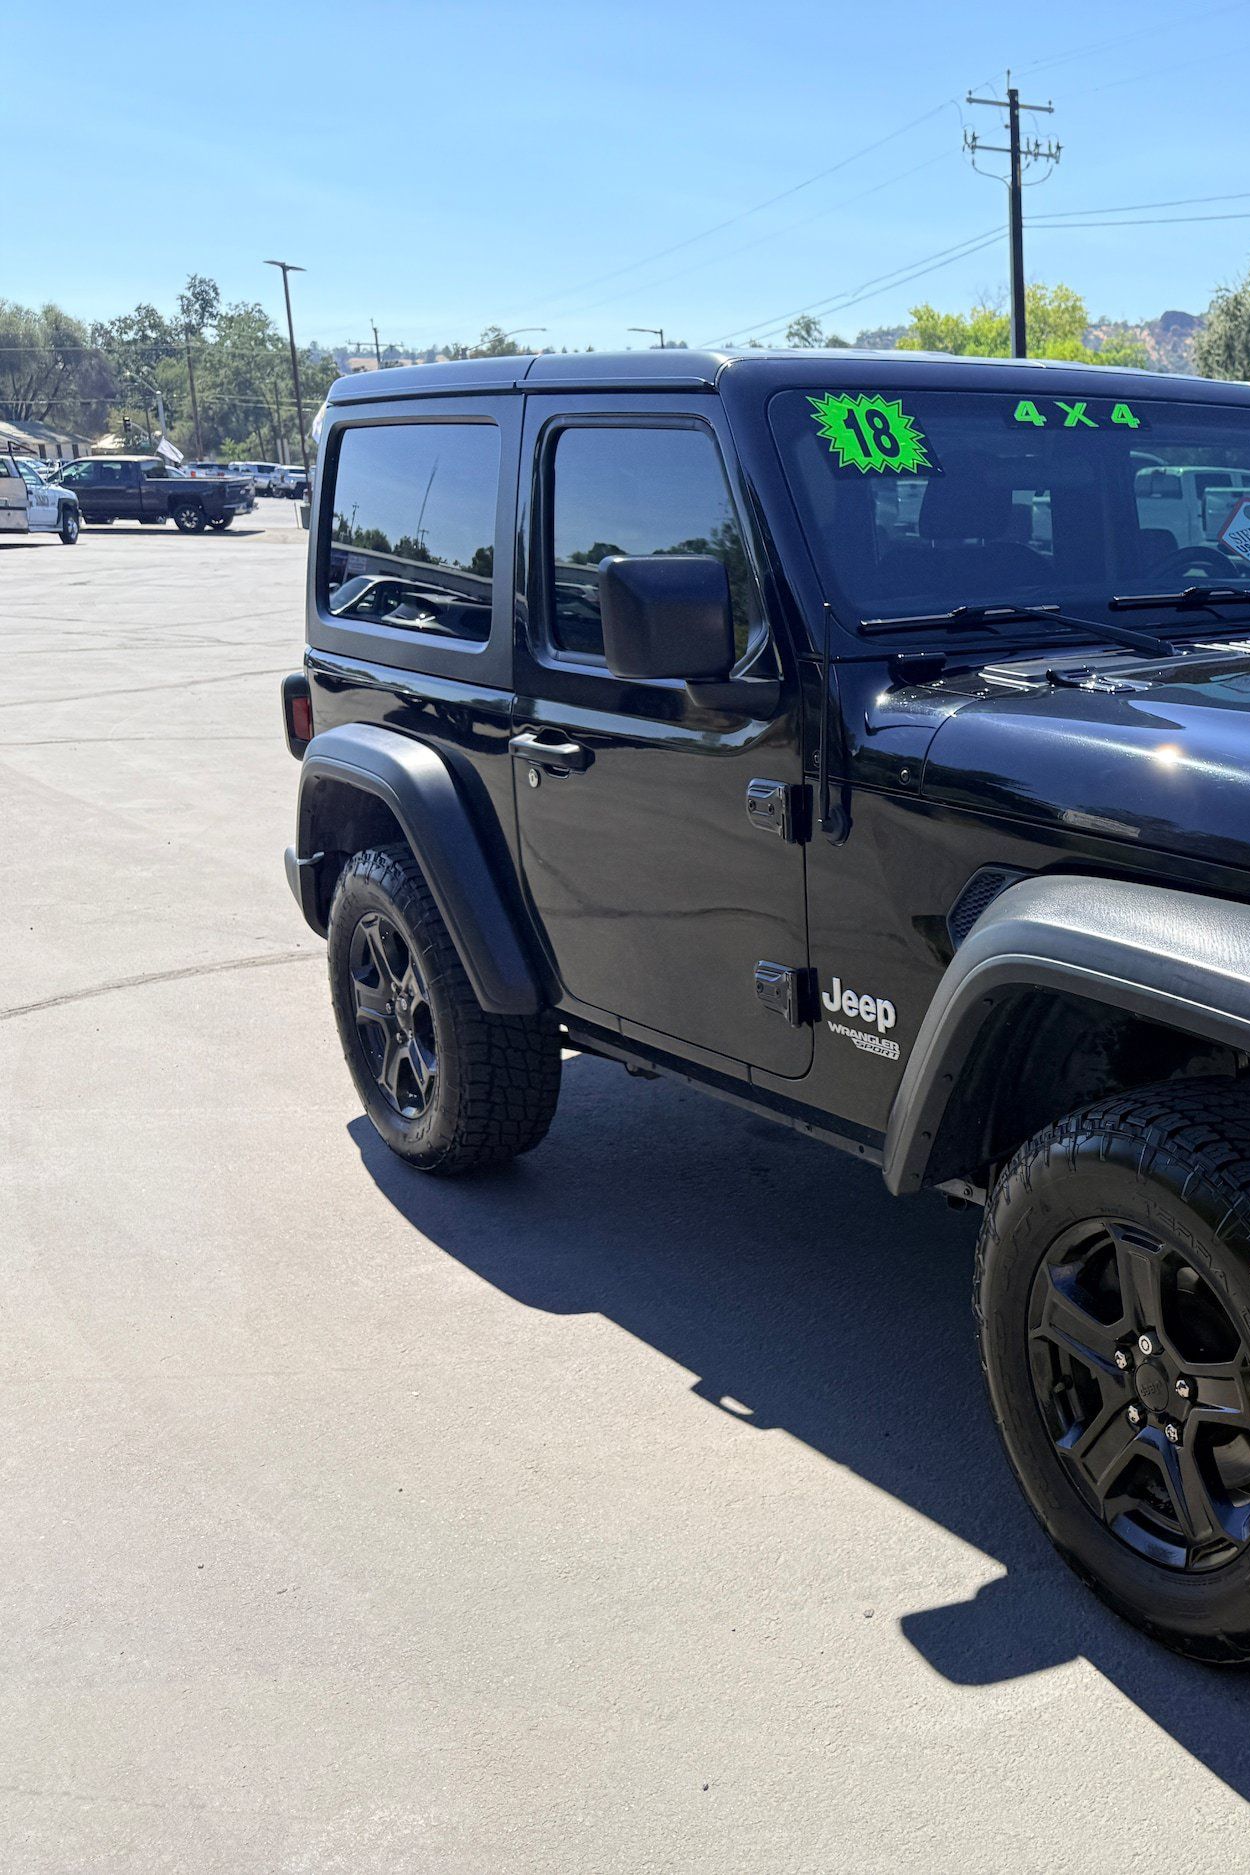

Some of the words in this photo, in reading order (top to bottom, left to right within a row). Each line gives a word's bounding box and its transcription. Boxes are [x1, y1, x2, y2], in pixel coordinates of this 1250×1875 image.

[842, 408, 901, 459] 18
[822, 977, 897, 1034] Jeep
[827, 1020, 900, 1052] WRANGLER
[855, 1040, 899, 1059] SPORT
